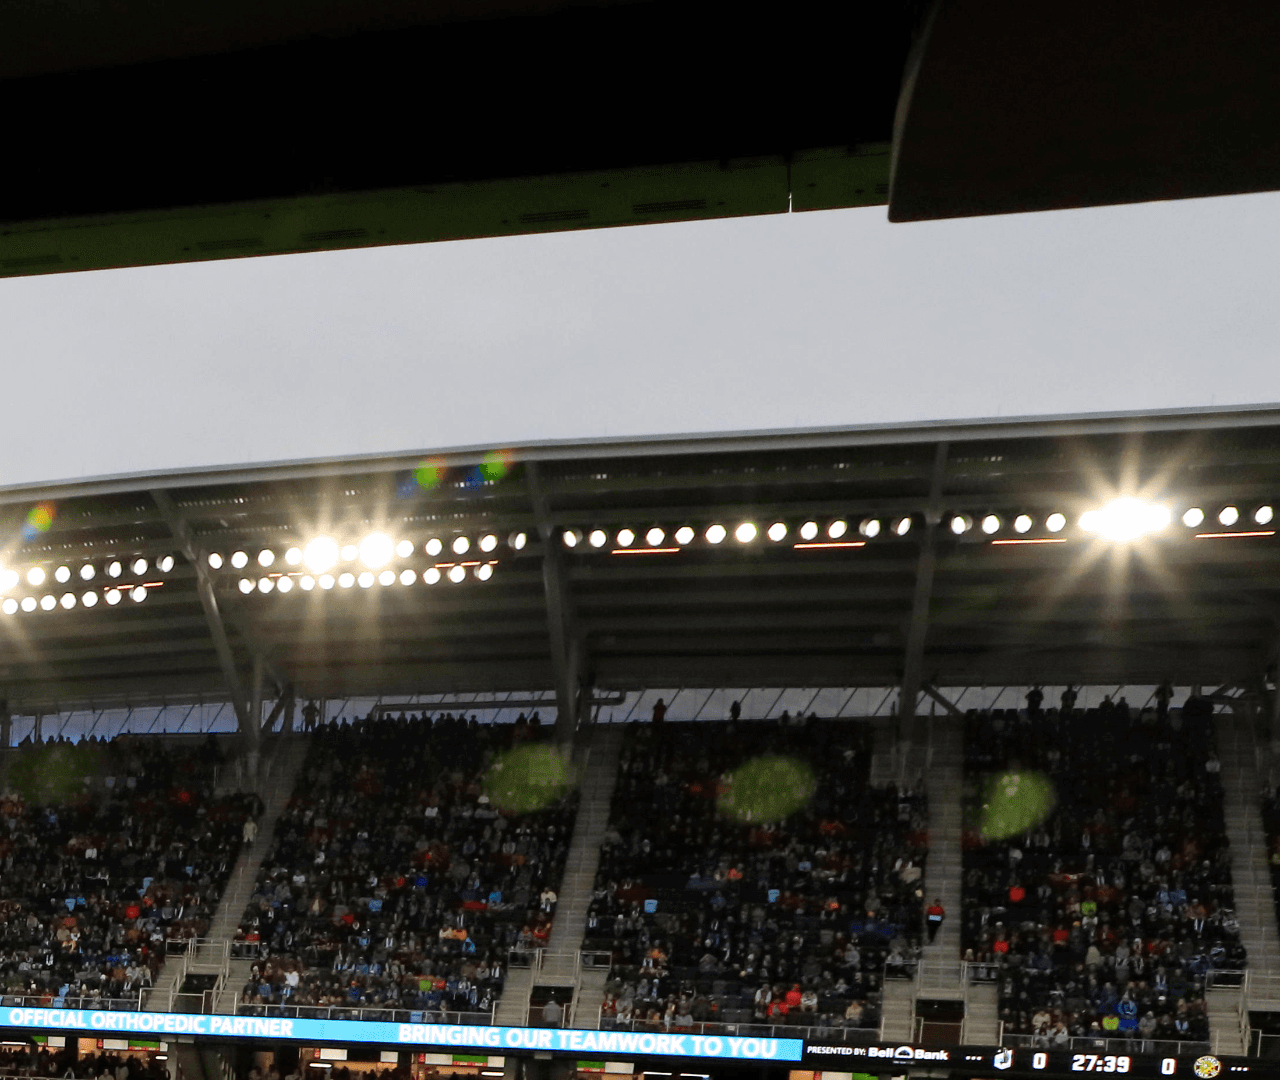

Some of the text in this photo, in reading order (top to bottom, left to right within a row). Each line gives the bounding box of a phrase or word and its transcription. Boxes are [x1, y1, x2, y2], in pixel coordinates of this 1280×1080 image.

[10, 1008, 293, 1037] OFFICIAL ORTHOPEDIC PARTNER
[399, 1023, 777, 1058] BRINGING OUR TEAMWORK TO YOU
[806, 1046, 852, 1055] PRESENTED
[867, 1046, 949, 1061] Bell Bank
[1032, 1052, 1047, 1070] 0
[1071, 1054, 1131, 1073] 27:39
[1161, 1058, 1176, 1075] 0
